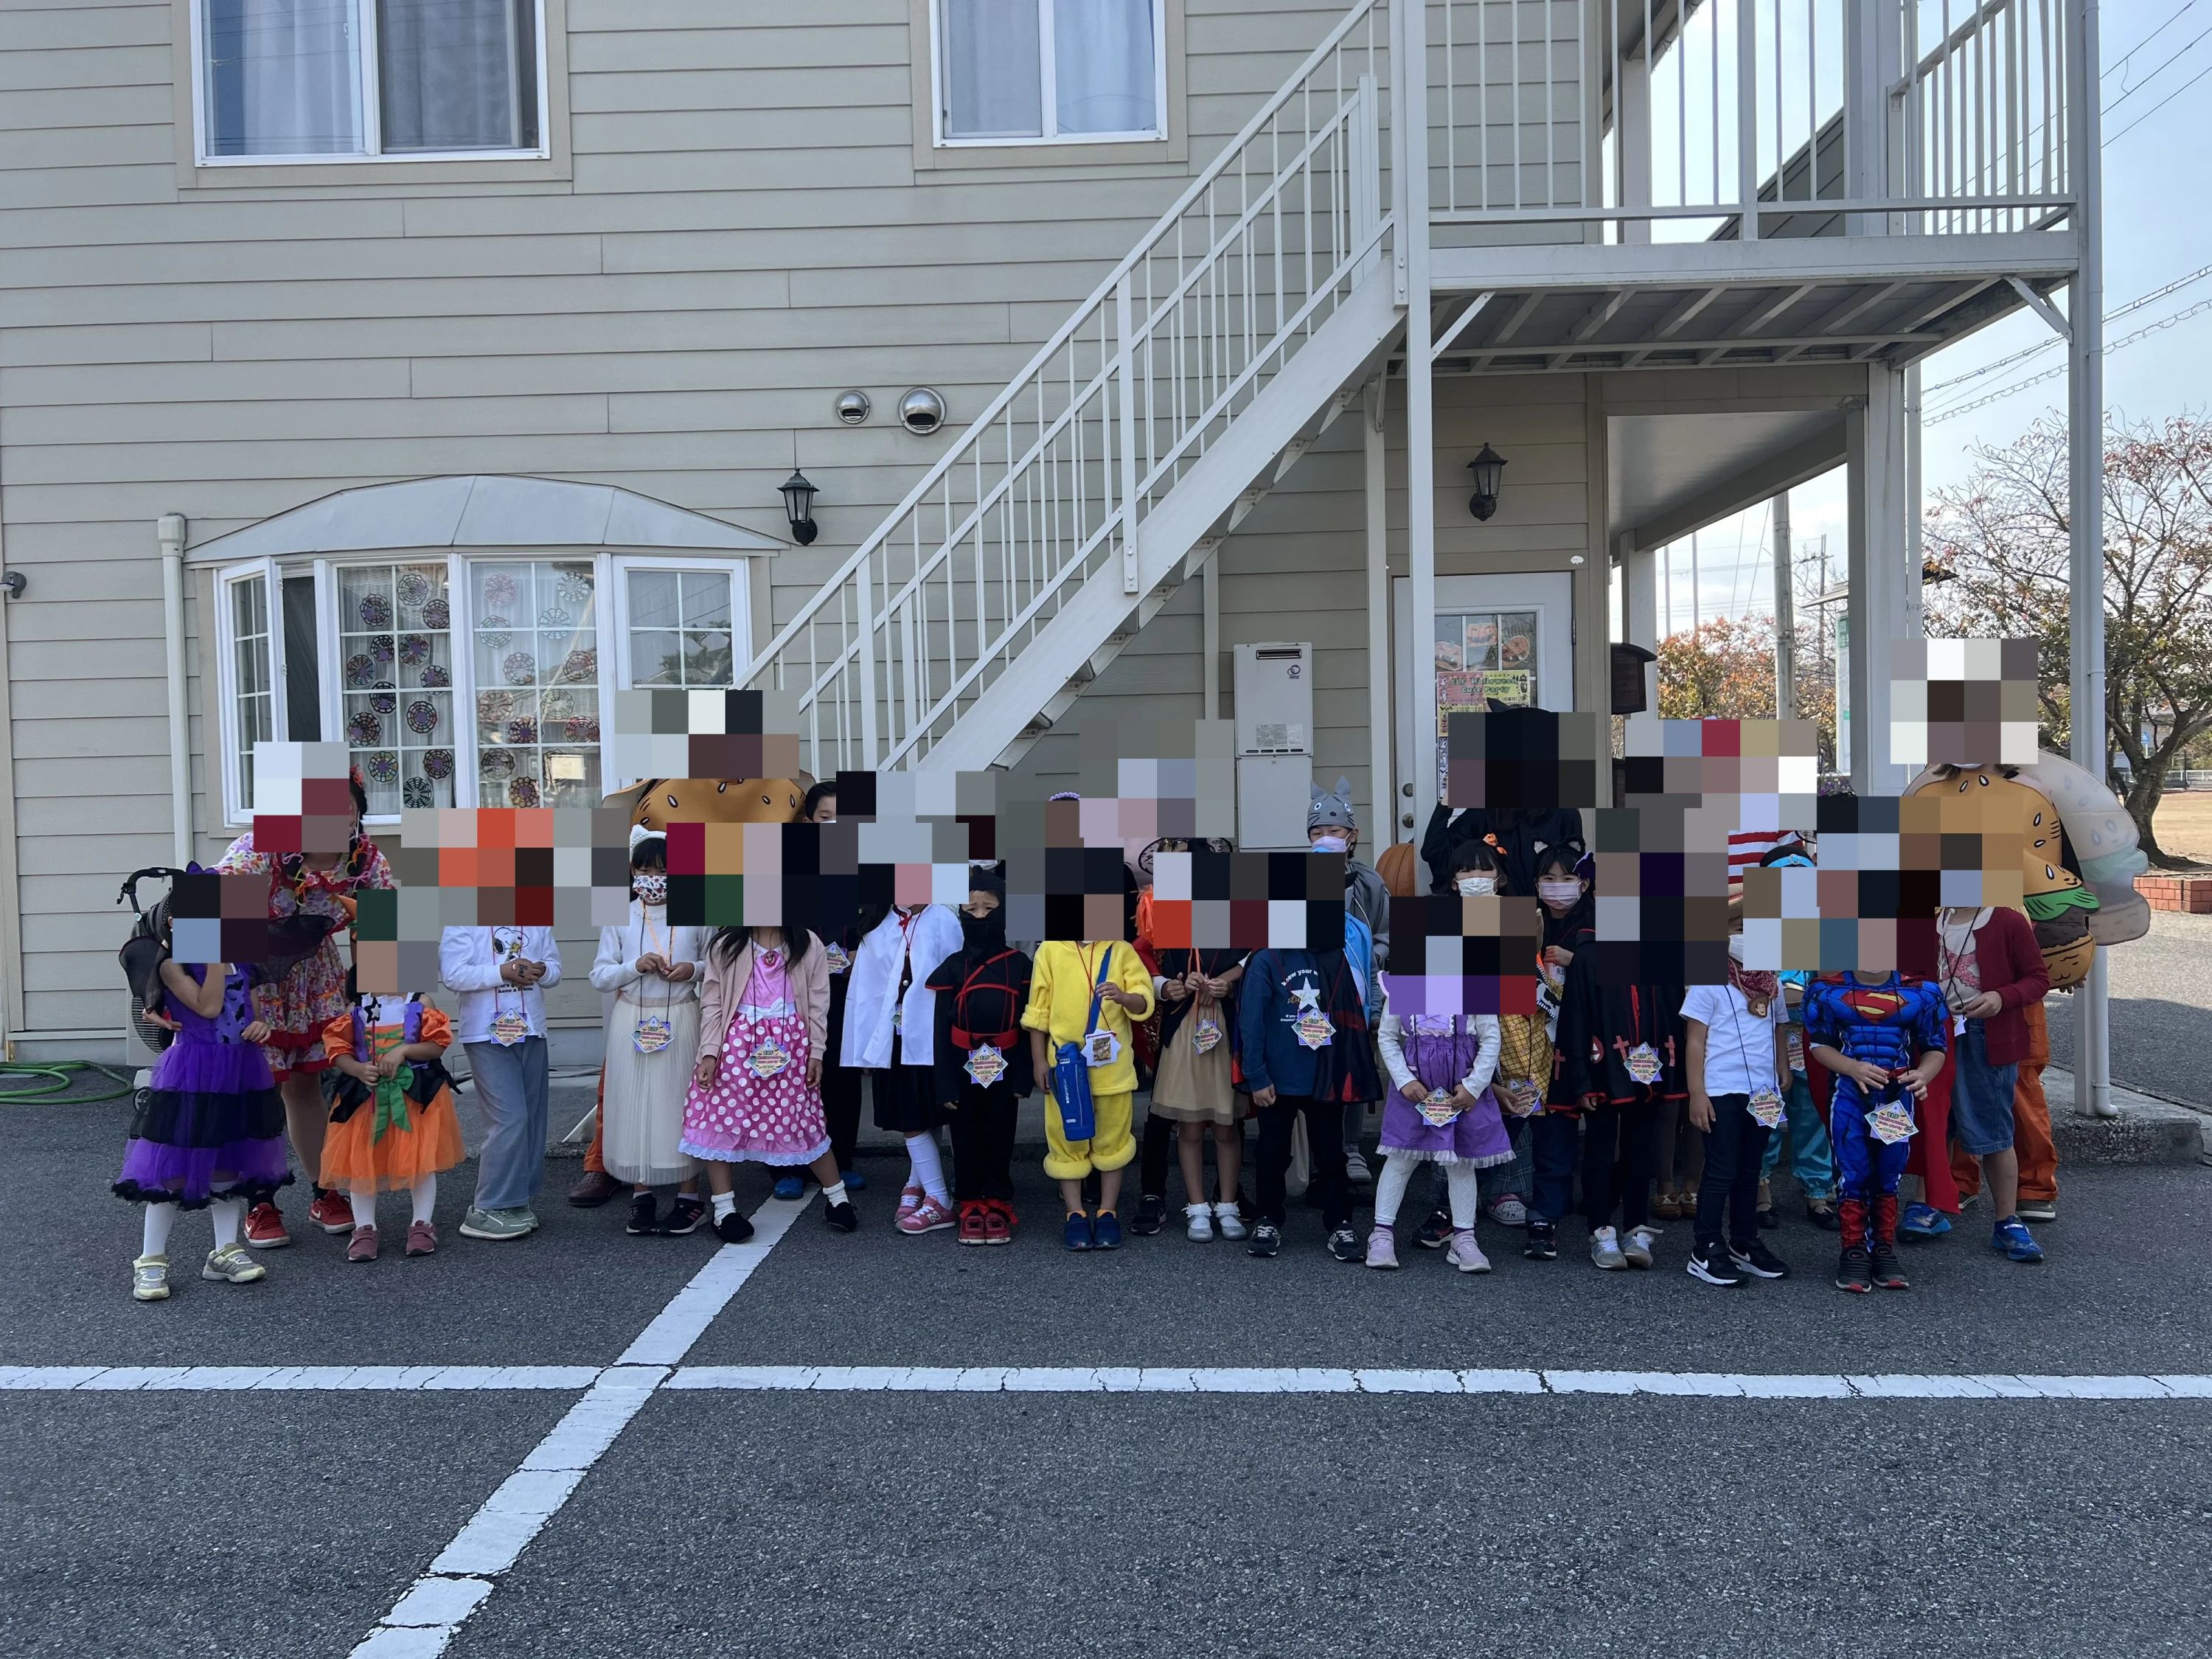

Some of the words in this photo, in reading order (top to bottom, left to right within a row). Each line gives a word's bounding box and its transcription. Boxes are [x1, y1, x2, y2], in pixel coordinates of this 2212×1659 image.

[1471, 677, 1517, 685] Halloween
[1484, 686, 1510, 694] Party
[927, 1211, 942, 1223] N
